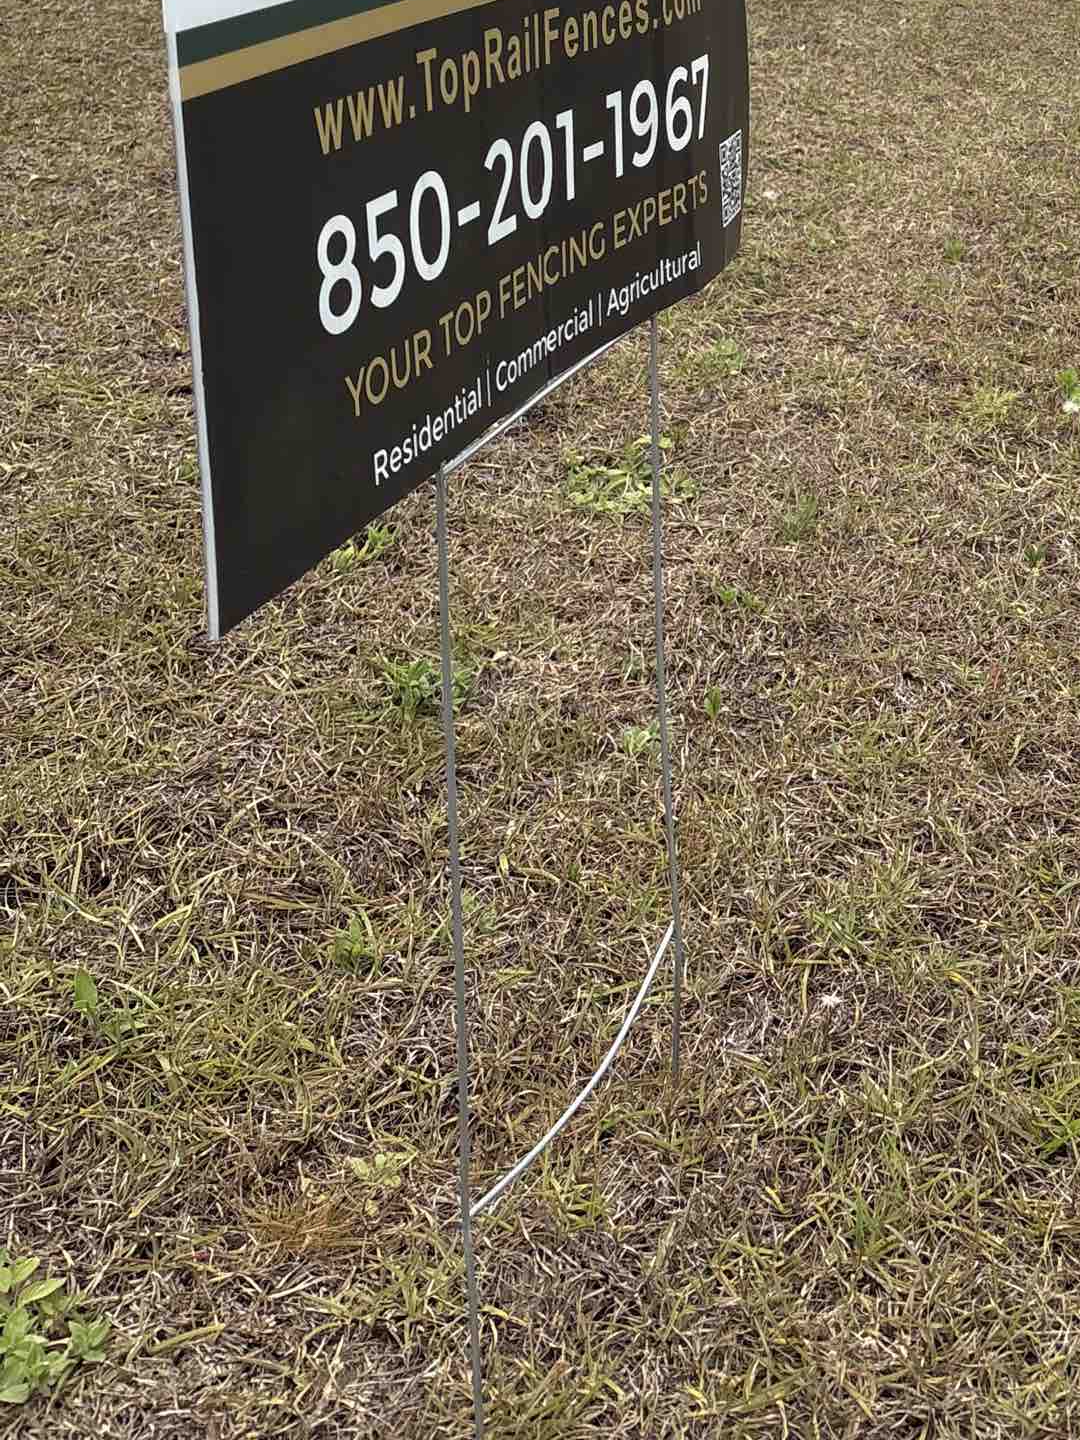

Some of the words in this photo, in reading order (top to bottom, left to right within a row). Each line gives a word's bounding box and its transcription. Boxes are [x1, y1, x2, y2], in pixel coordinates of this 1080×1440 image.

[316, 54, 709, 335] 850-201-1967
[345, 329, 432, 417] YOUR
[439, 290, 491, 357] TOP
[499, 222, 605, 319] FENCING
[612, 170, 709, 250] EXPERTS
[374, 377, 482, 486] Residential
[495, 299, 594, 392] Commercial
[606, 241, 702, 318] Agricultural
